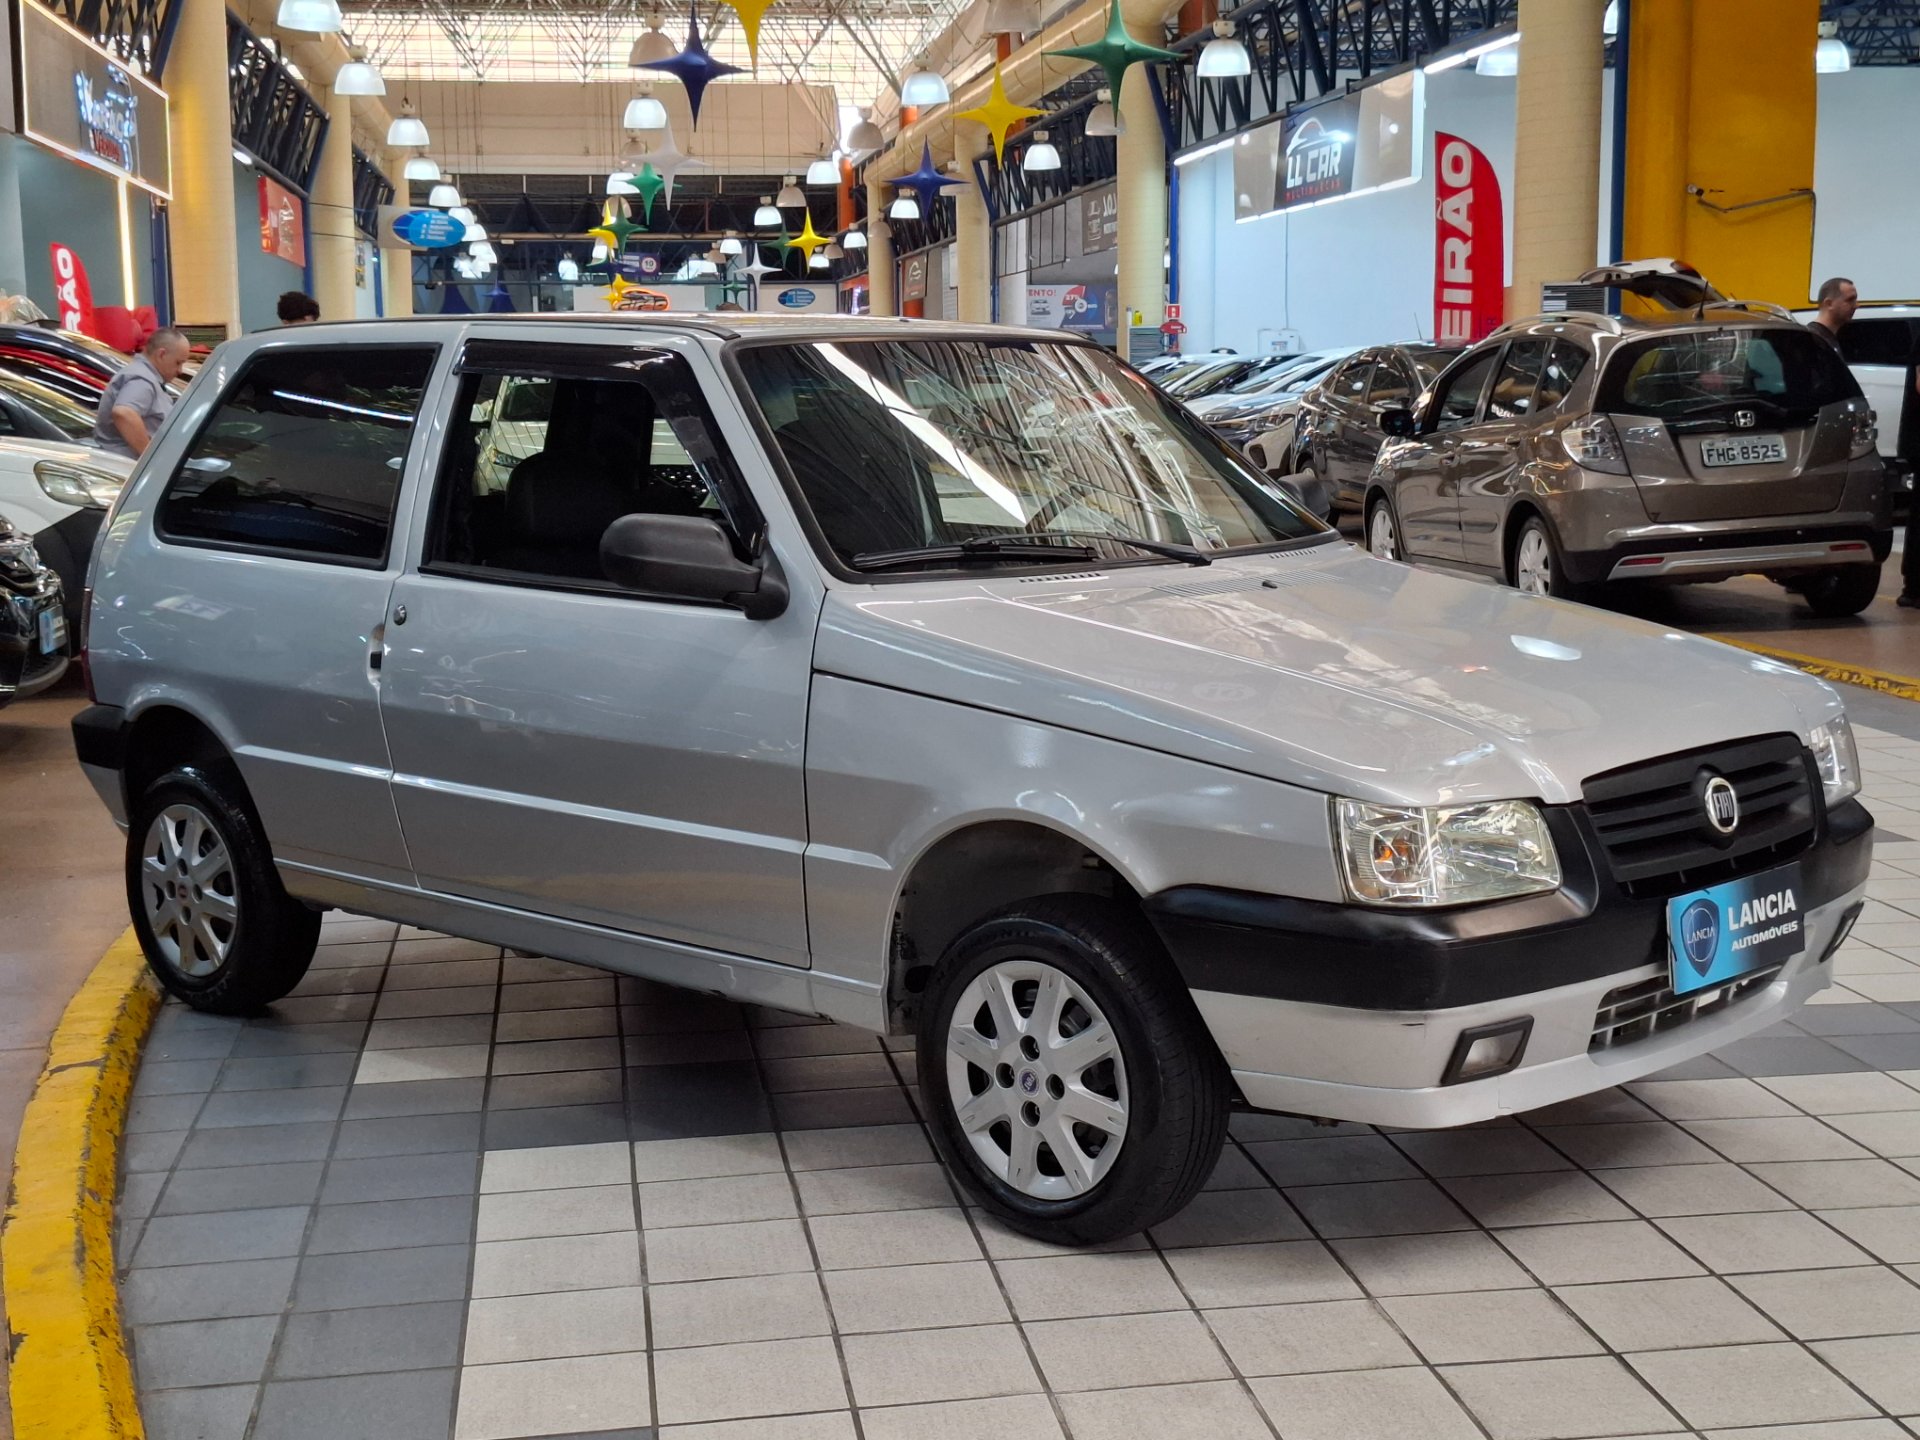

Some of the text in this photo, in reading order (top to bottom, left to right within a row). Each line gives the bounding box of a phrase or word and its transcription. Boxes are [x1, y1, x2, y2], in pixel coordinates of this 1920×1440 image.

[1286, 142, 1342, 188] LL CAR
[1712, 791, 1734, 819] FIAT
[1727, 888, 1797, 931] LANCIA
[1686, 925, 1716, 944] LANCIA
[1731, 920, 1798, 952] AUTOMÓVEIS
